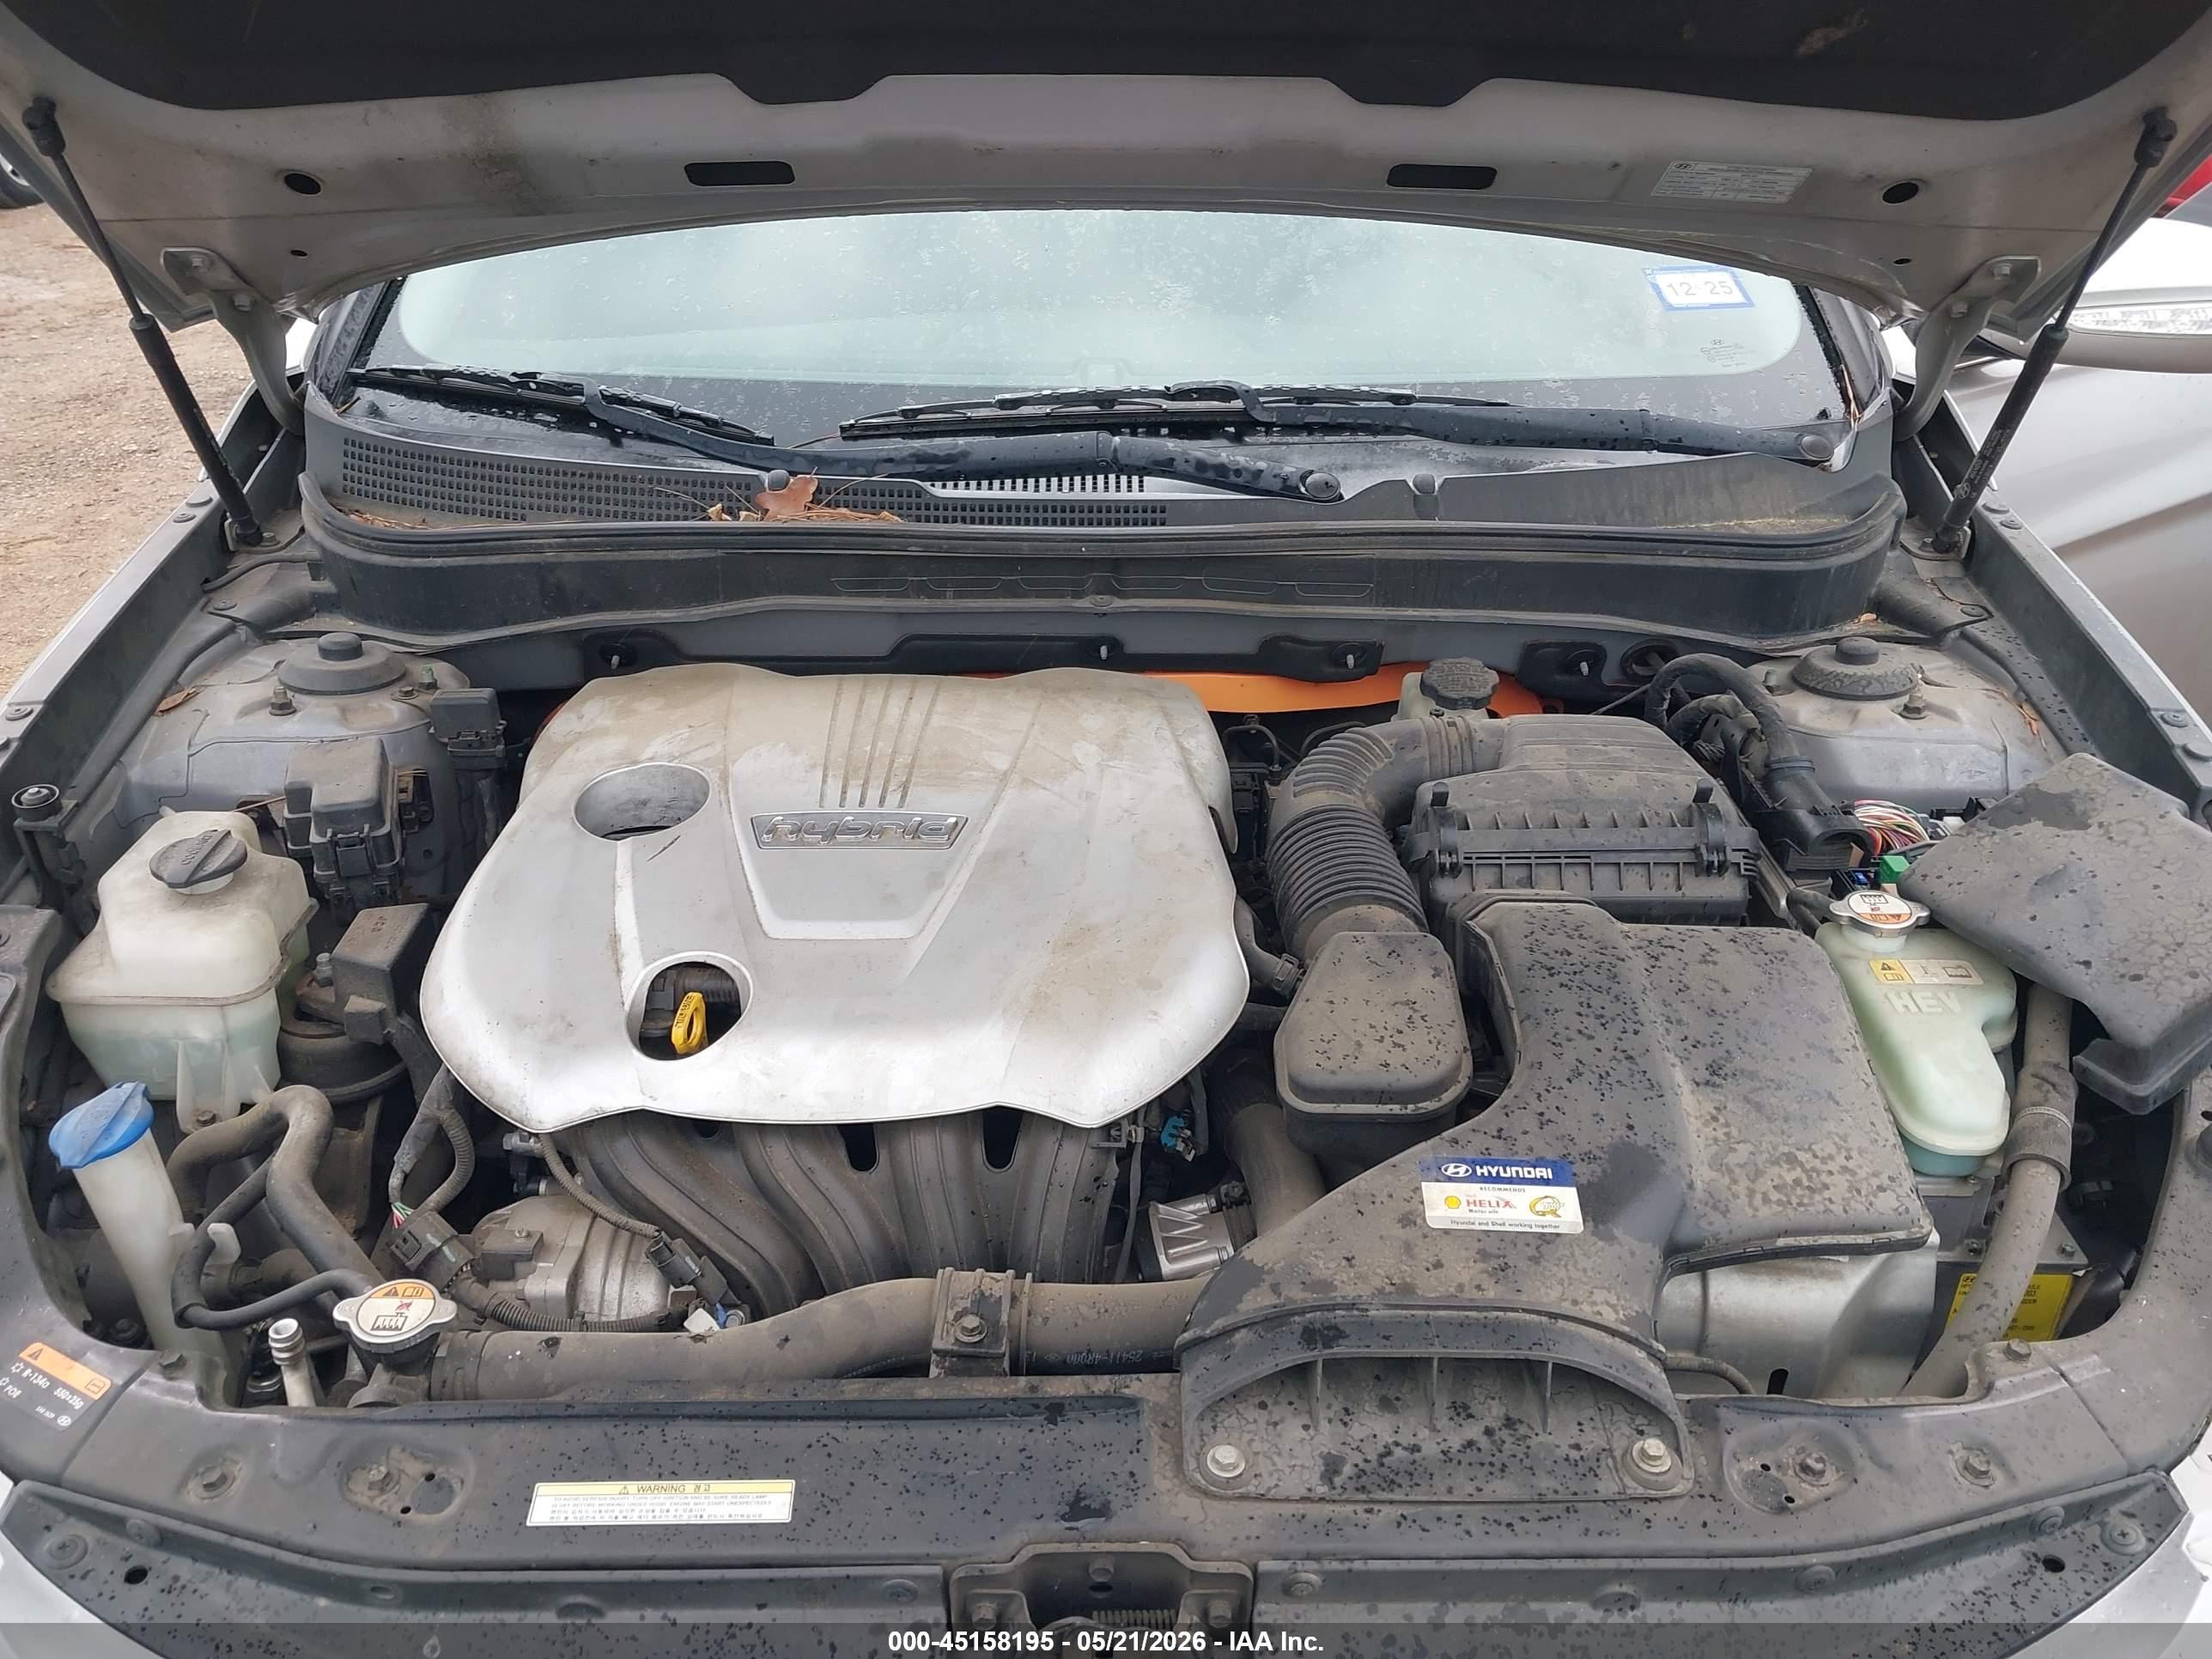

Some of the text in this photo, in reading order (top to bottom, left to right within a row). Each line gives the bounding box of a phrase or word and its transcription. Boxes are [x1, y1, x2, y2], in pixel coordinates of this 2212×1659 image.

[762, 816, 958, 845] hybrid
[1886, 990, 1962, 1014] HEV
[1475, 1165, 1553, 1180] HYUNDAI
[1467, 1199, 1514, 1209] HELIX
[21, 1368, 51, 1389] R-134a
[637, 1484, 685, 1494] WARNING
